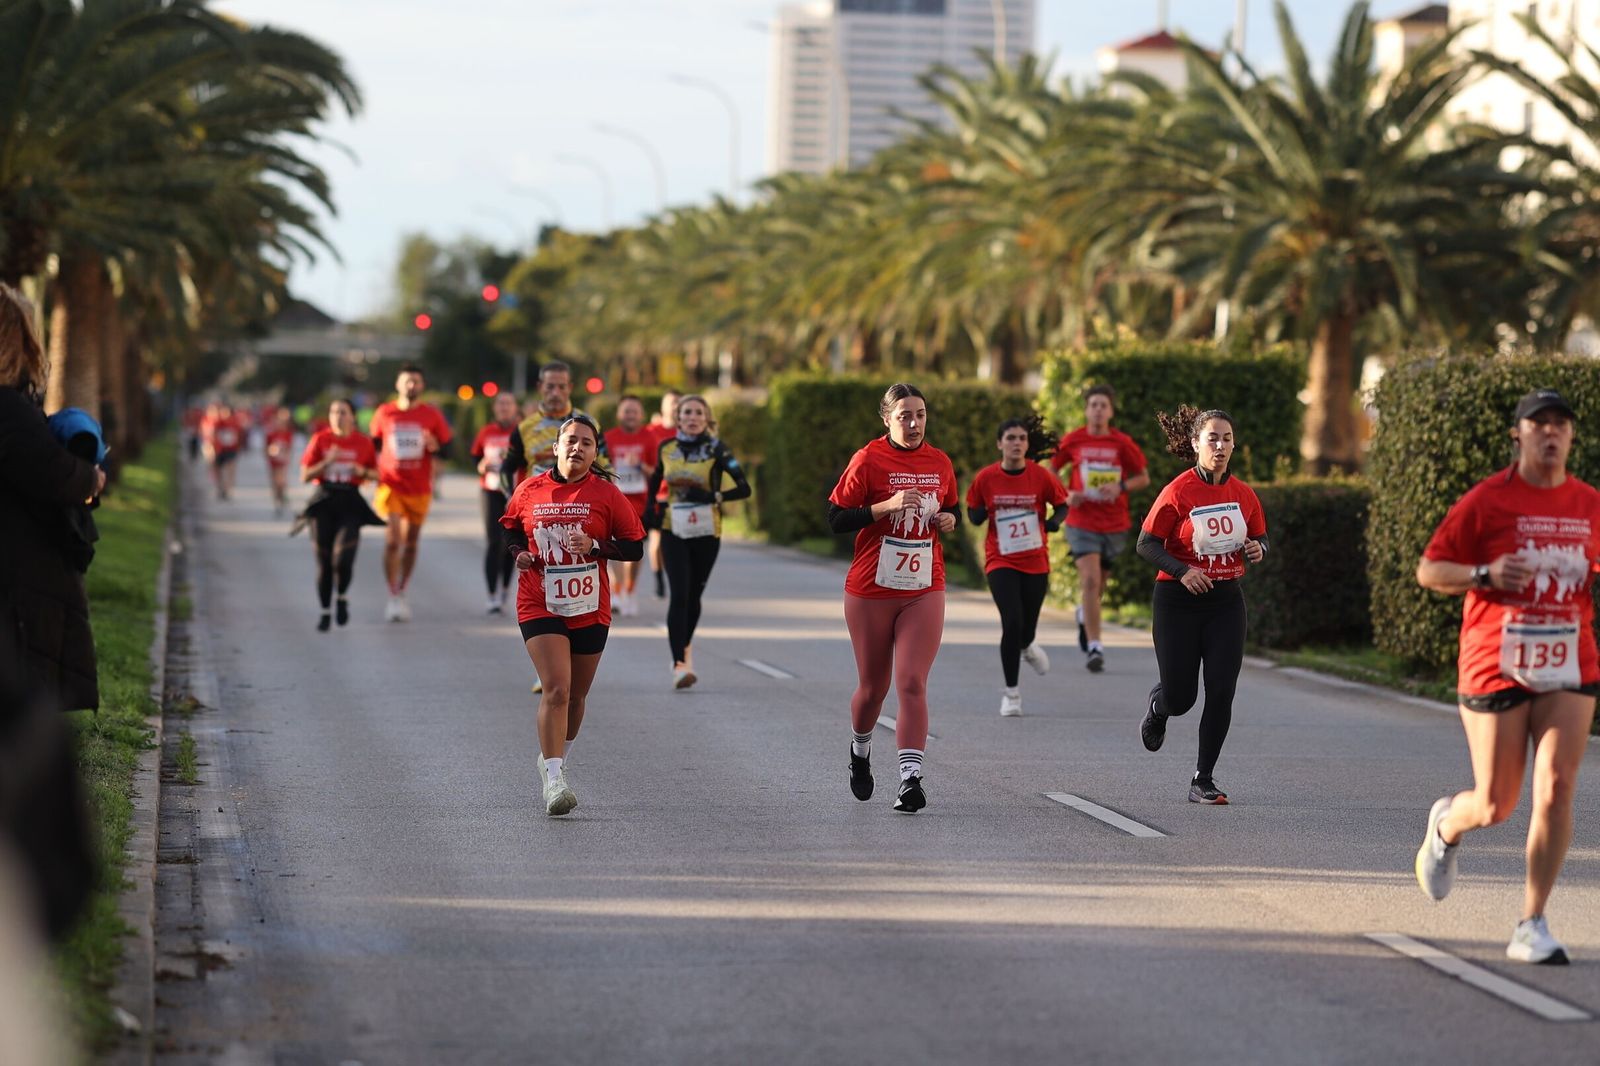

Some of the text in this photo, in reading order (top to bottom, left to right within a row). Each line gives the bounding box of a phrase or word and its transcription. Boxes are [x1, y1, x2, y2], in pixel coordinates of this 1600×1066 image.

[889, 477, 917, 485] CIUDAD
[532, 507, 590, 516] CIUDAD JARDÍN
[688, 511, 698, 524] 4
[1009, 521, 1031, 539] 21
[1207, 515, 1234, 537] 90
[895, 551, 921, 573] 76
[553, 575, 594, 599] 108
[1512, 640, 1568, 670] 139
